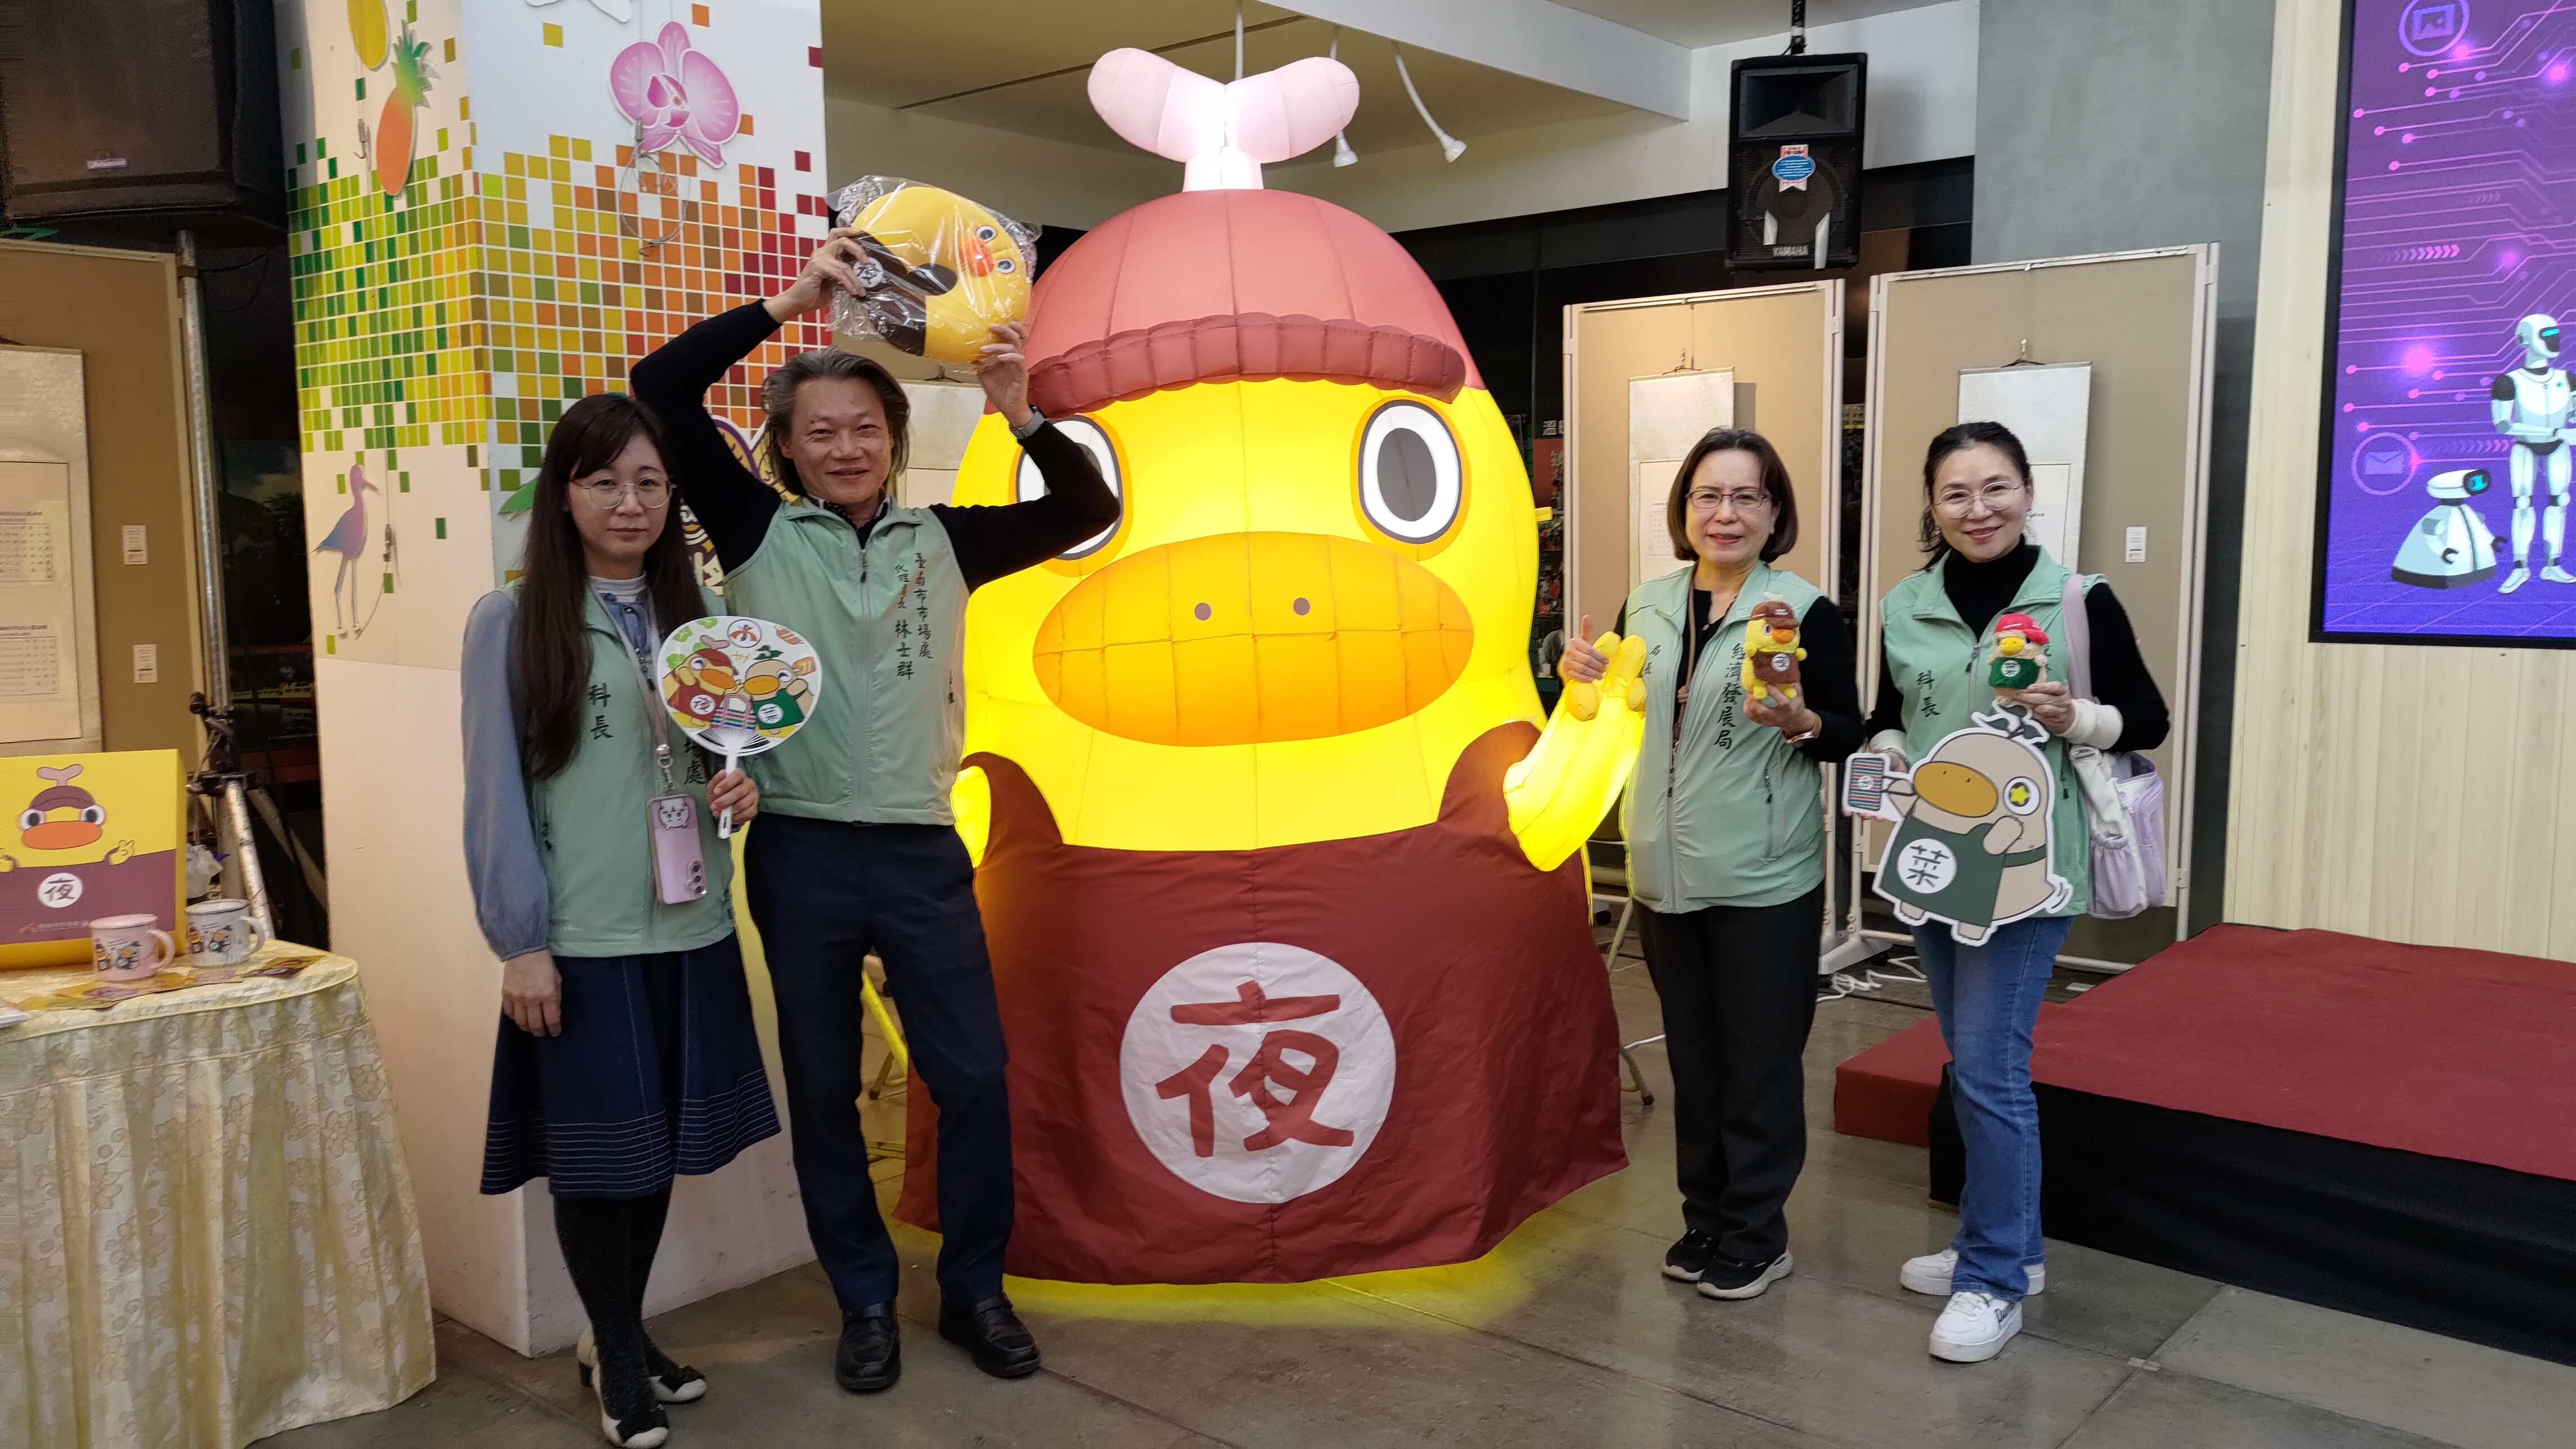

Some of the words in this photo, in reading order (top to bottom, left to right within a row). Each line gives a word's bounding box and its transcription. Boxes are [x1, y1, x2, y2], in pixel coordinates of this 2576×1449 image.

[1773, 245, 1809, 257] YAMAHA
[914, 552, 933, 659] 臺南市市場處
[895, 619, 915, 681] 林士群
[588, 682, 614, 741] 科長
[1714, 642, 1747, 750] 經濟發展局
[1916, 669, 1942, 718] 科長
[44, 876, 75, 902] 夜
[1906, 844, 1949, 888] 菜
[1155, 979, 1355, 1158] 夜
